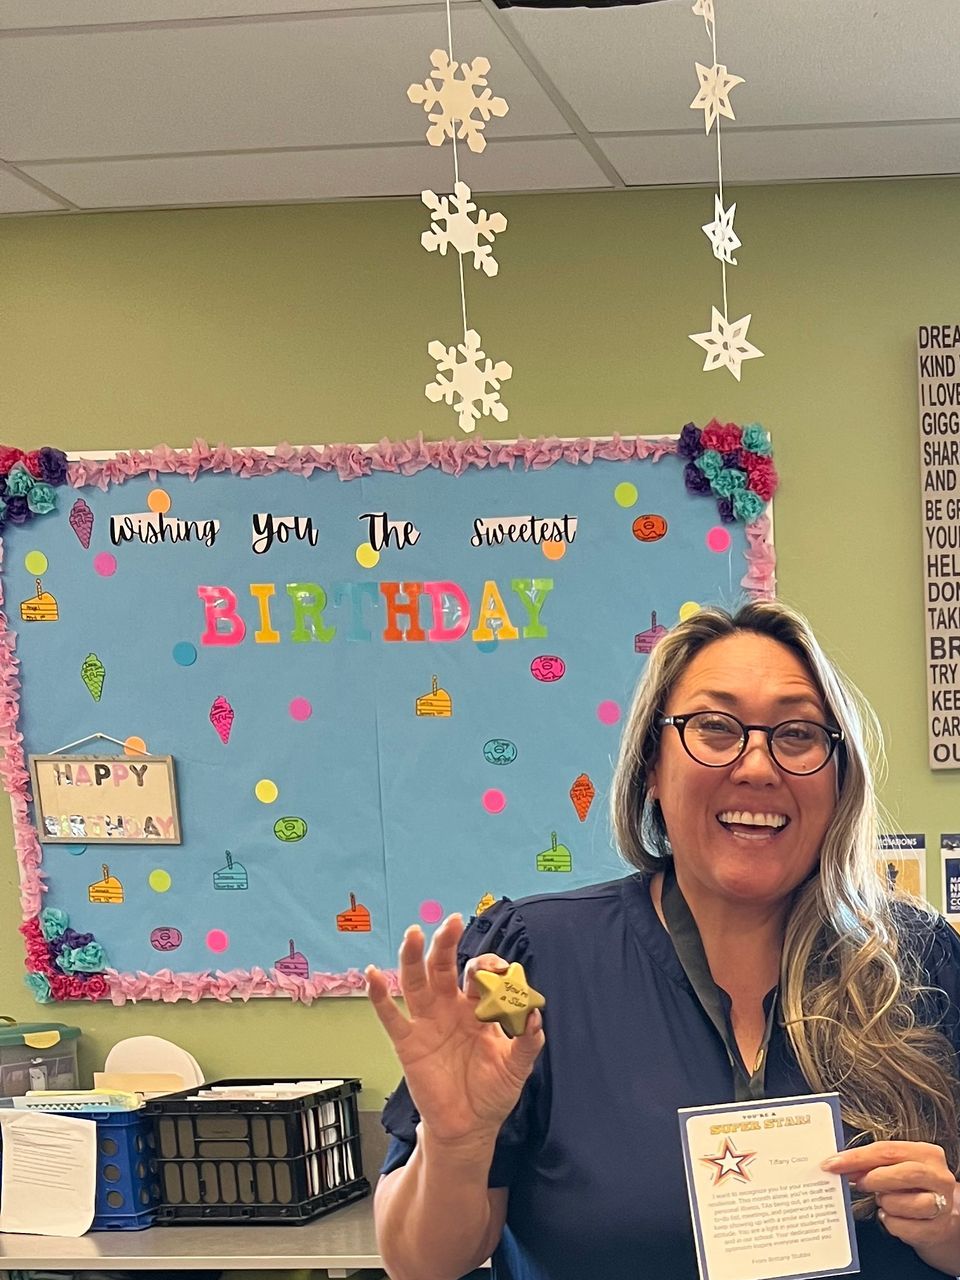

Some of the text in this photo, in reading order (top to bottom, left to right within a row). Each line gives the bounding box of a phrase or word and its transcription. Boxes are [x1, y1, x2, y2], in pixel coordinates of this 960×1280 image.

[920, 355, 955, 377] KIND
[921, 384, 925, 406] I
[925, 470, 956, 491] AND
[926, 500, 942, 520] BE
[110, 512, 577, 554] Wishing You The Sweetest
[198, 578, 554, 646] BIRTHDAY
[930, 664, 957, 684] TRY
[53, 763, 148, 787] HAPPY
[44, 815, 174, 838] BIRTHDAY
[504, 981, 529, 998] You're
[710, 1115, 811, 1135] SUPER STAR!
